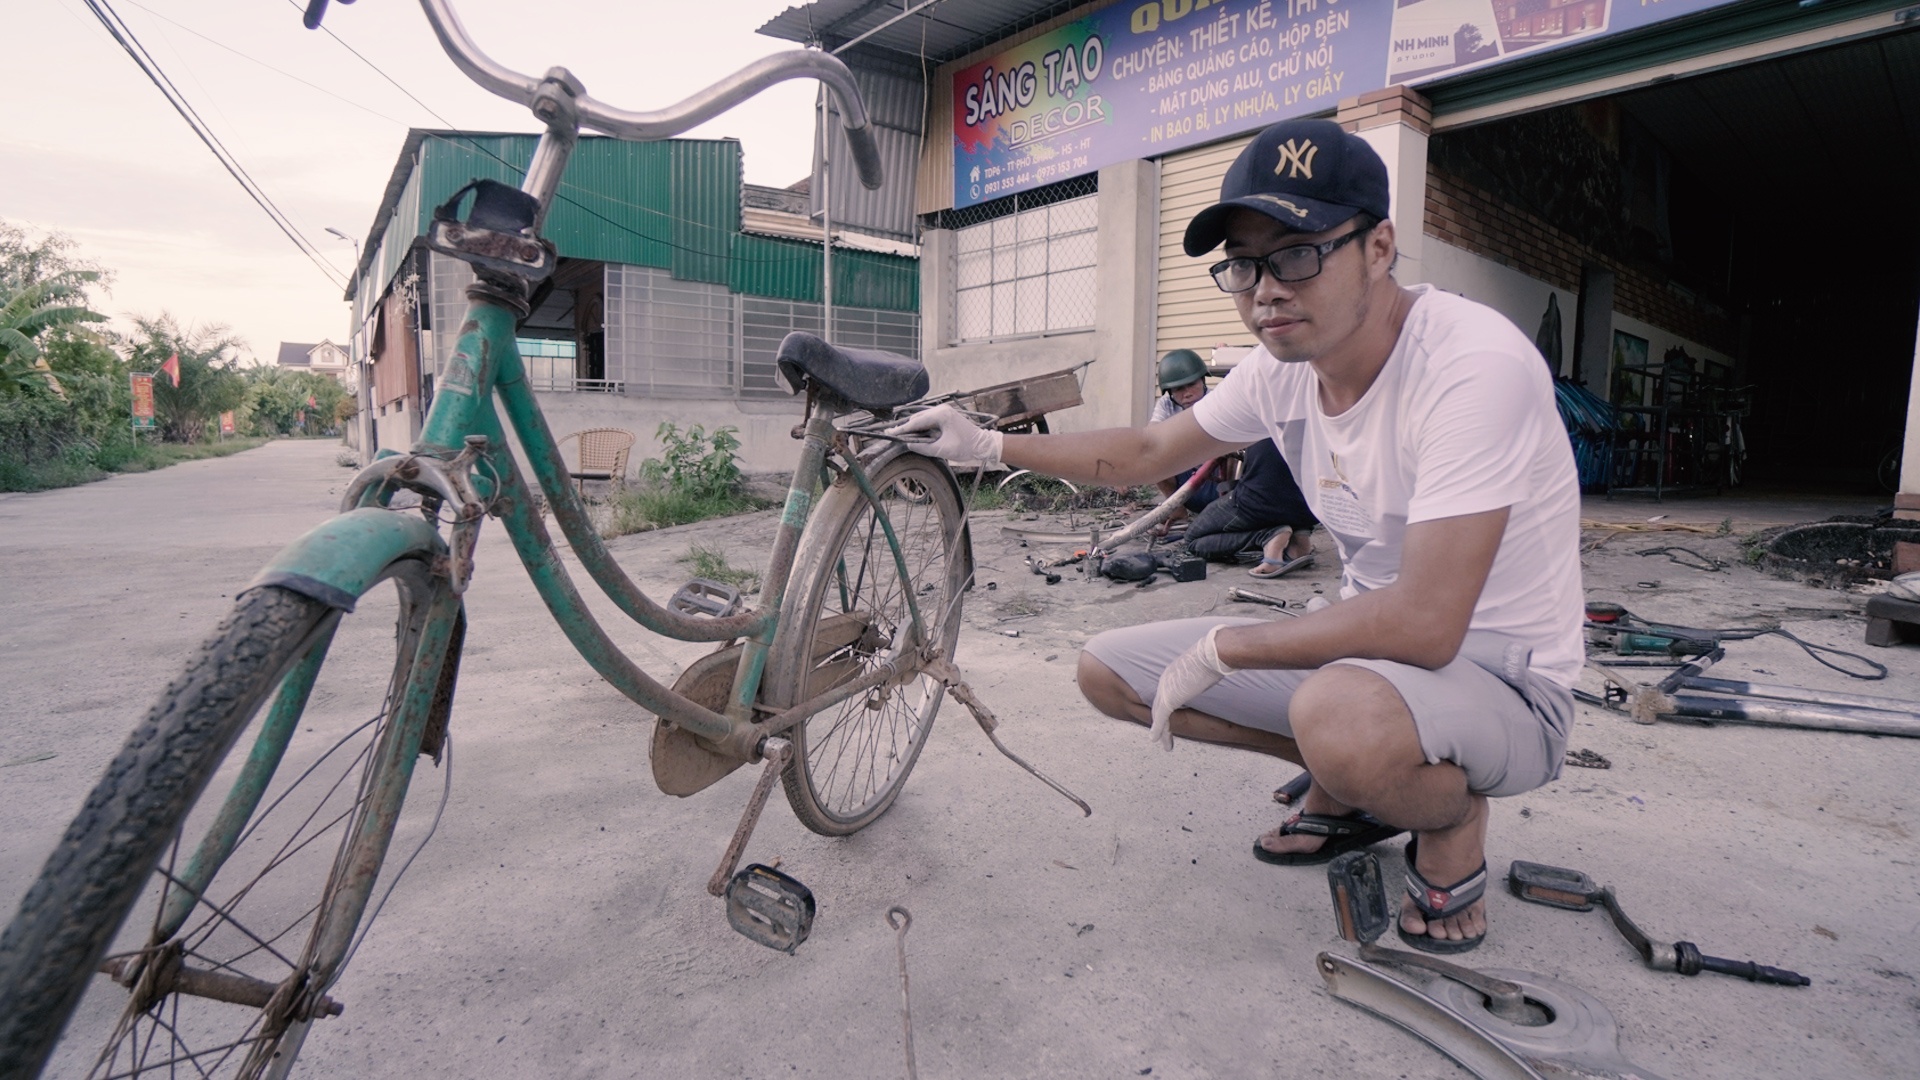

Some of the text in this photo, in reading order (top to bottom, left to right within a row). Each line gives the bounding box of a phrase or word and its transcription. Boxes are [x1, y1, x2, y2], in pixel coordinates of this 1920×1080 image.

[1113, 36, 1184, 80] CHUYÊN:
[1190, 5, 1240, 53] THIẾT
[1149, 67, 1183, 93] BẢNG
[1187, 49, 1235, 80] QUẢNG
[1239, 36, 1273, 63] CÁO,
[1279, 22, 1311, 50] HỘP
[1315, 9, 1349, 39] ĐÈN
[1397, 51, 1435, 62] STUDIO
[1417, 35, 1449, 50] MINH
[966, 34, 1103, 126] SÁNG TẠO
[1159, 89, 1187, 116] MẶT
[1191, 77, 1229, 107] DỰNG
[1233, 68, 1263, 93] ALU,
[1268, 50, 1301, 82] CHỮ
[1305, 35, 1333, 71] NỔI
[1011, 95, 1105, 147] DECOR
[1151, 125, 1162, 143] IN
[1167, 117, 1192, 139] BAO
[1196, 107, 1211, 131] BÌ,
[1215, 104, 1230, 126] LY
[1234, 90, 1279, 119] NHỰA,
[1285, 83, 1301, 106] LY
[1306, 65, 1344, 100] GIẤY
[1061, 142, 1073, 155] HS
[1080, 137, 1091, 150] HT
[1274, 138, 1318, 179] NY
[984, 182, 1000, 194] 0931
[1002, 177, 1015, 189] 353
[1016, 172, 1030, 185] 444
[1057, 160, 1070, 173] 153
[1072, 154, 1088, 169] 704
